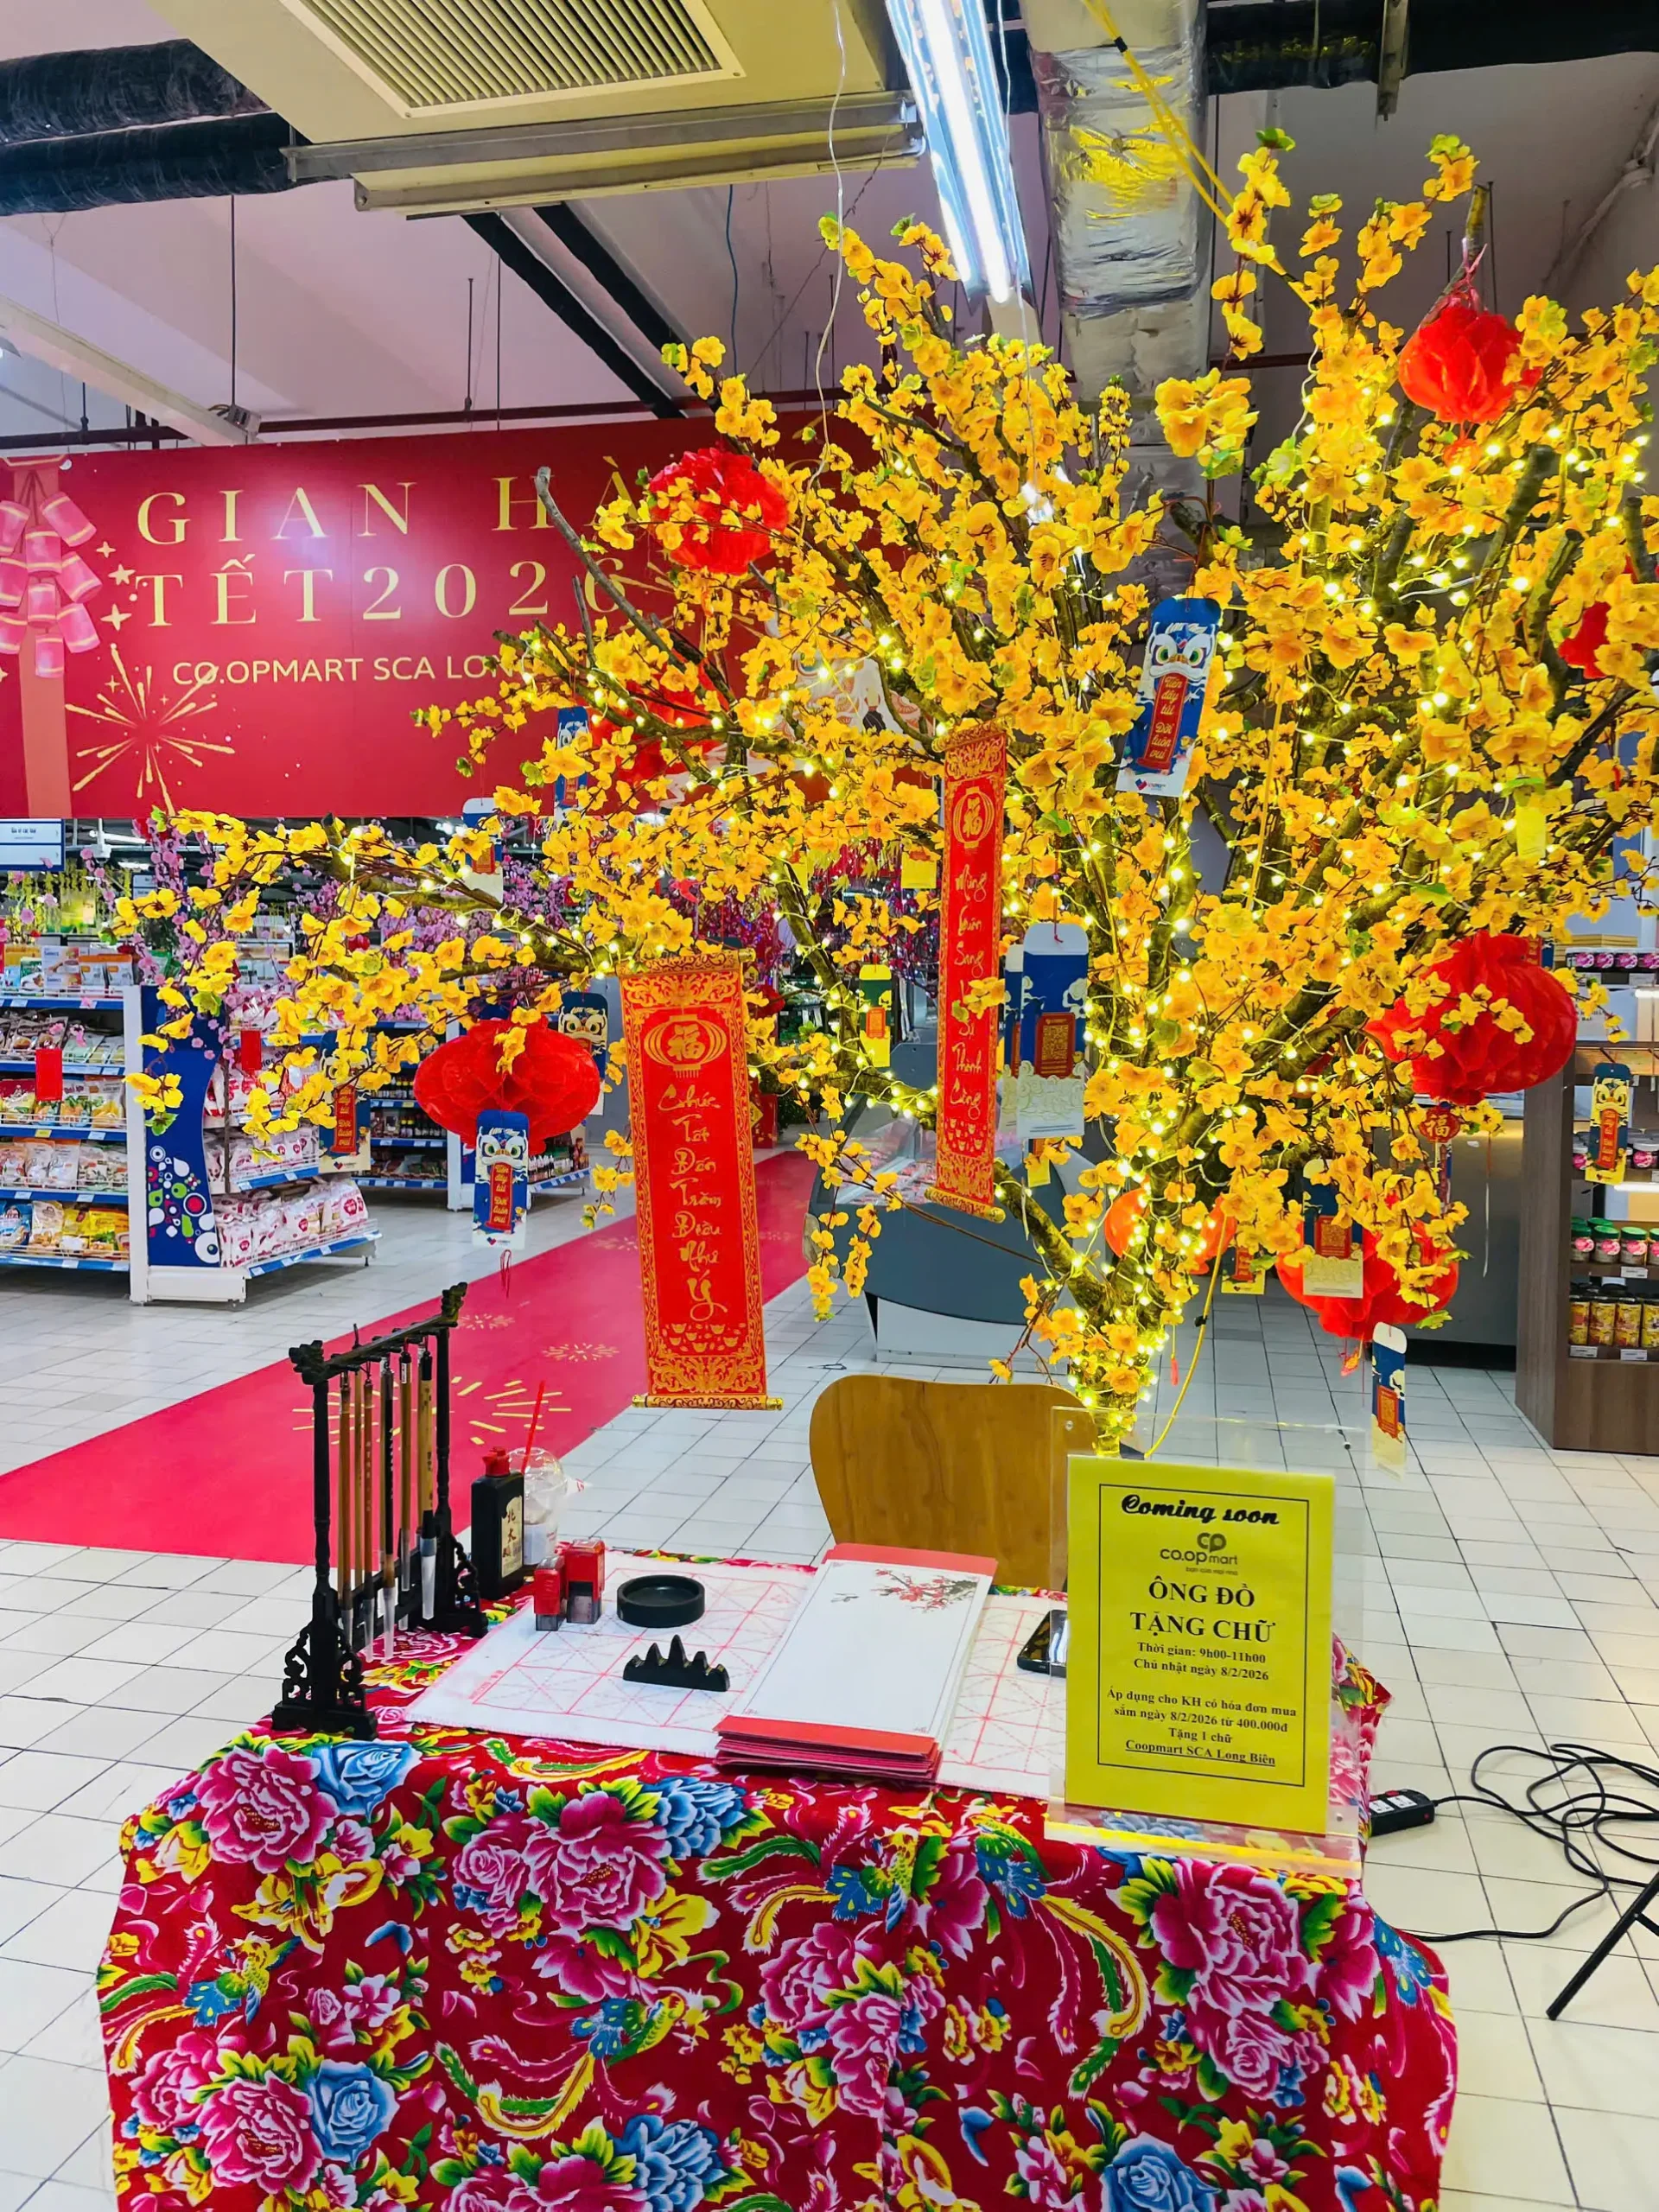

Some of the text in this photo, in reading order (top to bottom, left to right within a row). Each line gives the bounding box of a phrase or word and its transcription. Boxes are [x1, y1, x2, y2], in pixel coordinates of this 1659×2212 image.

[137, 481, 417, 546] GIAN
[134, 553, 626, 627] TẾT 2026
[173, 658, 364, 685] CO.OPMART
[373, 657, 435, 681] SCA
[668, 1024, 705, 1061] 福
[1425, 1114, 1451, 1137] 福
[670, 1177, 721, 1208] Trăm
[686, 1270, 728, 1321] Ý
[1122, 1494, 1280, 1524] Coming soon
[1148, 1575, 1255, 1607] ÔNG ĐỒ
[1130, 1611, 1276, 1643] TẶNG CHỮ
[1137, 1642, 1266, 1664] Thời gian: 9h00-11h00
[1161, 1661, 1186, 1675] nhật
[1190, 1666, 1217, 1678] ngày
[1220, 1668, 1269, 1681] 8/2/2026
[1107, 1686, 1297, 1717] Áp dụng cho KH có hóa đơn mua
[1140, 1710, 1166, 1723] ngày
[1170, 1712, 1217, 1726] 8/2/2026
[1236, 1718, 1288, 1733] 400.000đ
[1168, 1727, 1233, 1744] Tặng 1 chữ
[1125, 1739, 1276, 1766] Coopmart SCA Long Biên
